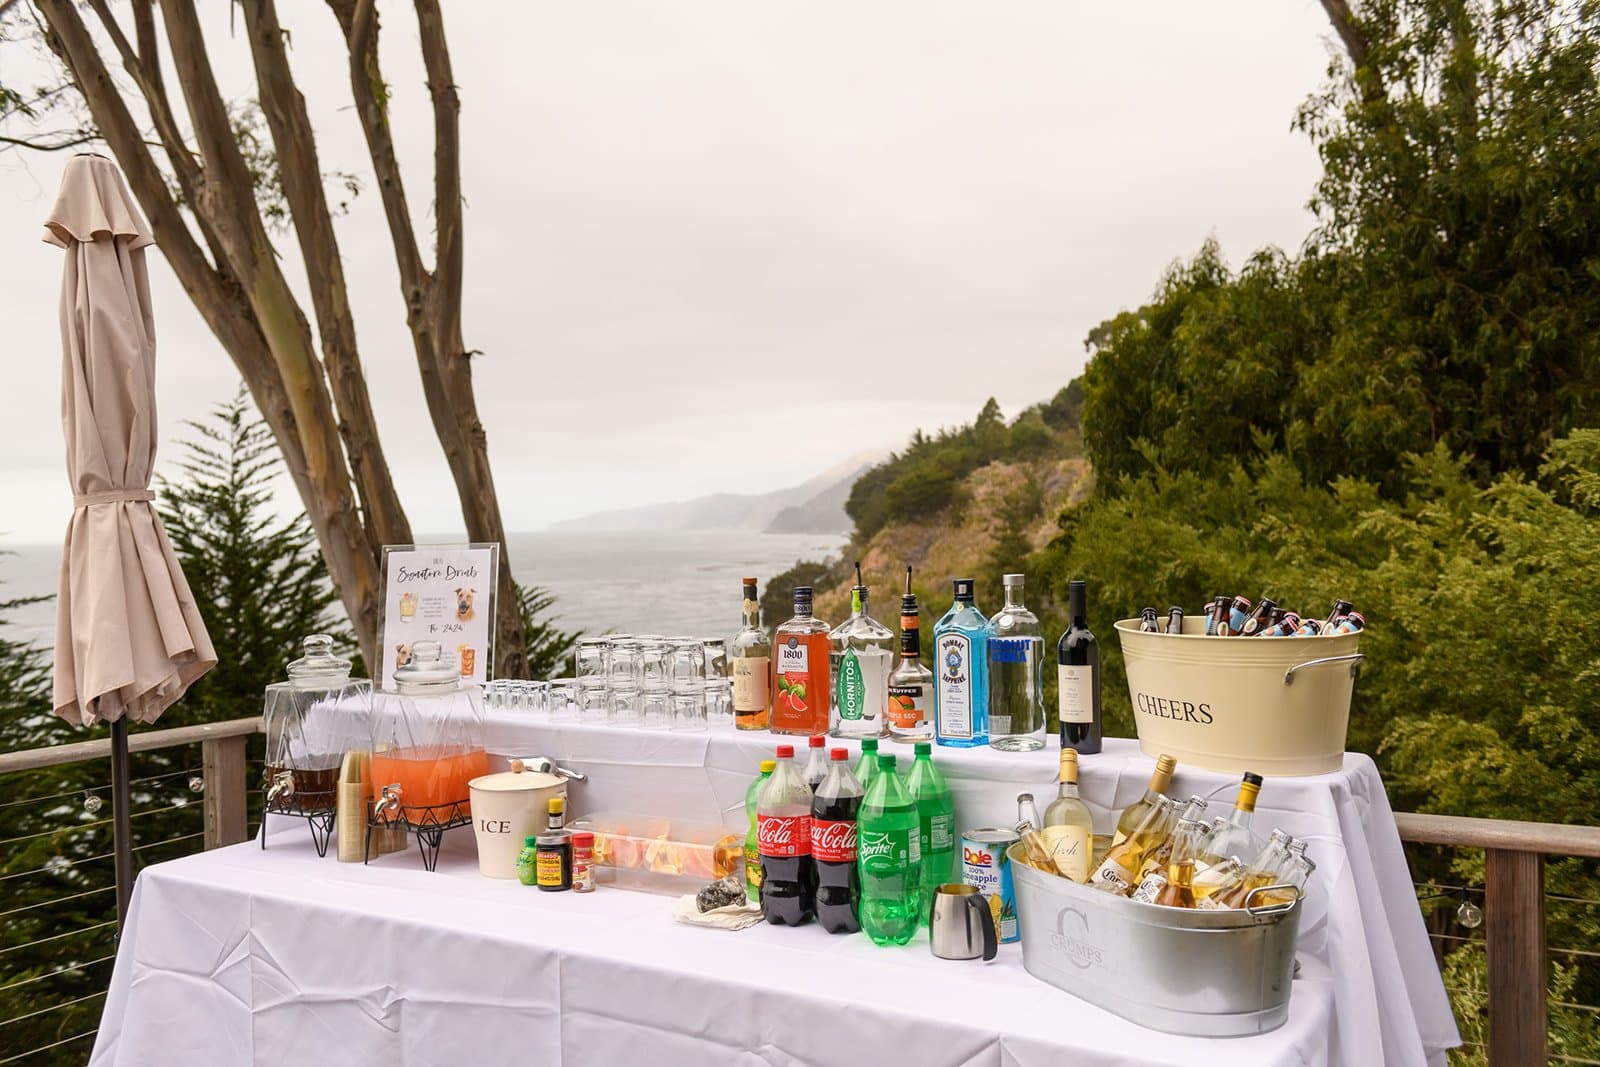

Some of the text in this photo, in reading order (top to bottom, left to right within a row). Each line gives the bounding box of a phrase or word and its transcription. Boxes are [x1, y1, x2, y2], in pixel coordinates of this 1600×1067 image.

[397, 566, 442, 583] Signature
[942, 640, 964, 652] BOMBAY
[784, 650, 803, 660] 1800
[846, 660, 855, 717] HORNITOS
[1137, 692, 1214, 725] CHEERS
[481, 819, 511, 834] ICE
[862, 842, 891, 857] Sprite
[964, 847, 992, 865] Dole
